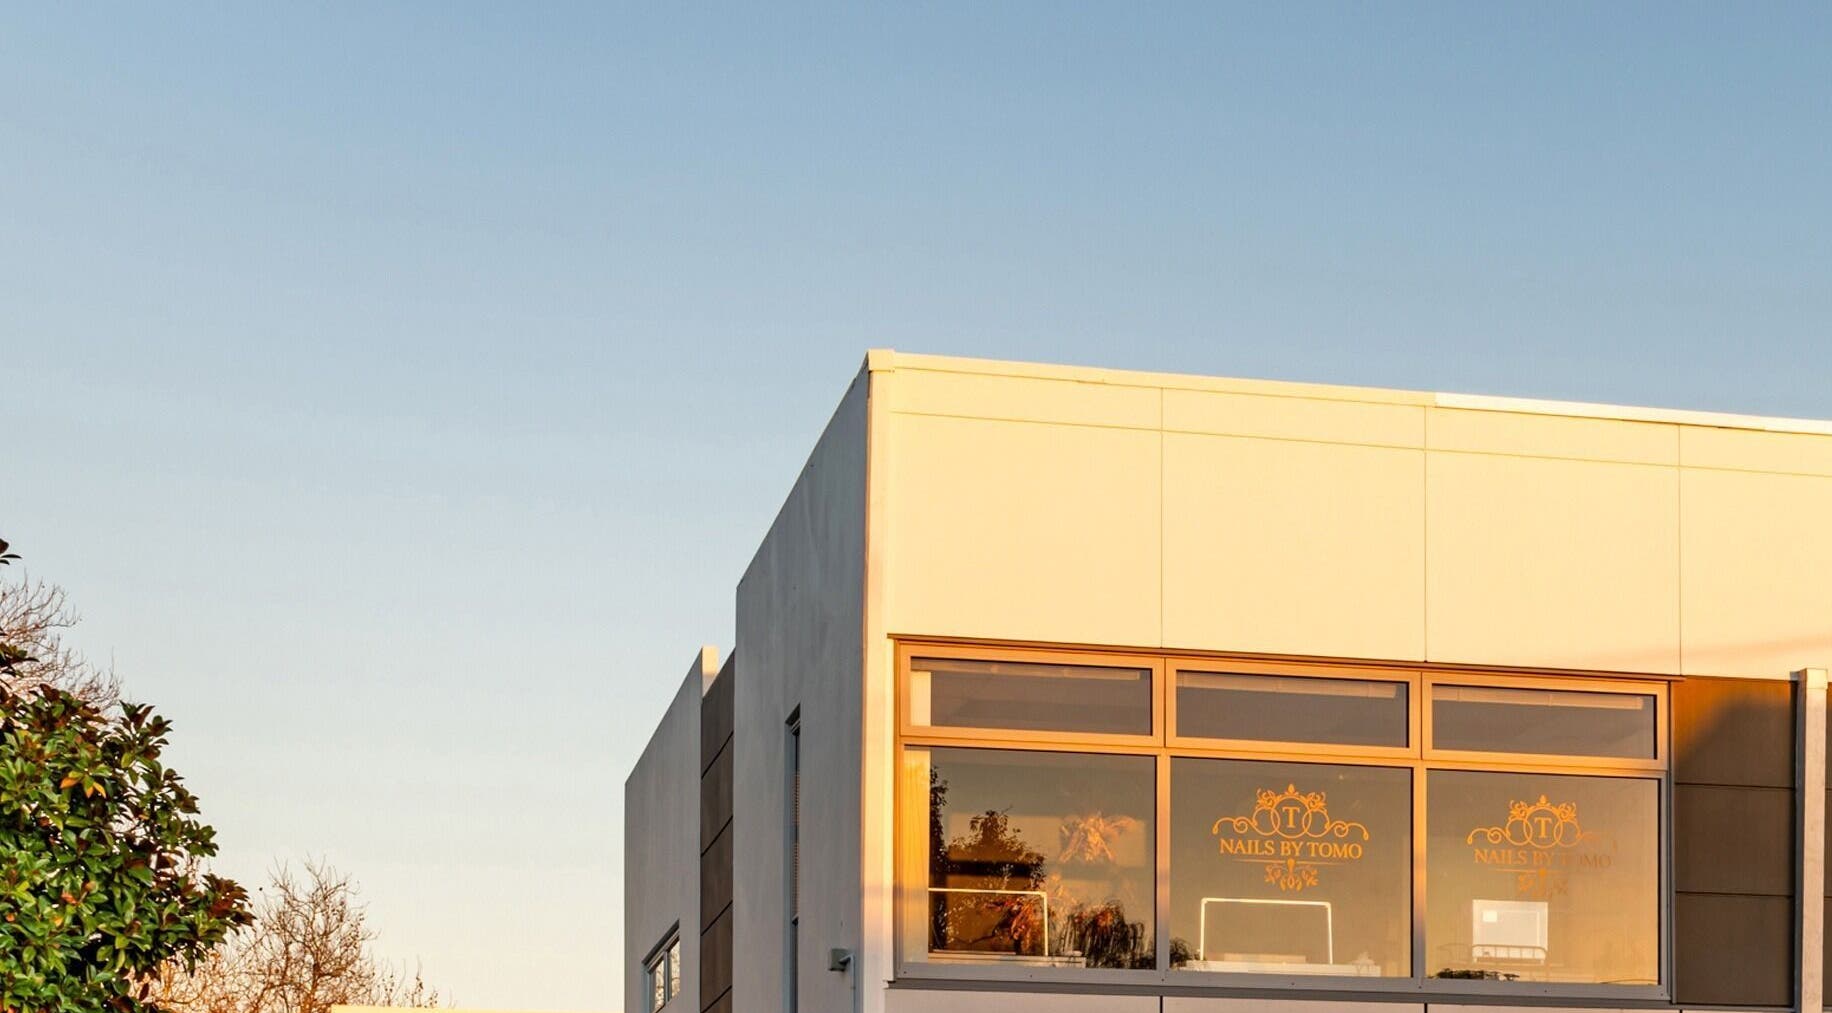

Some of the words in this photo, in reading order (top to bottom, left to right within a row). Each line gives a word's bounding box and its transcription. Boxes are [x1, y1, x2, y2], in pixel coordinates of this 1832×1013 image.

[1282, 806, 1300, 828] T
[1534, 817, 1553, 838] T
[1220, 838, 1275, 856] NAILS
[1280, 841, 1304, 857] BY
[1307, 841, 1363, 859] TOMO
[1474, 848, 1528, 865] NAILS
[1533, 851, 1555, 866] BY
